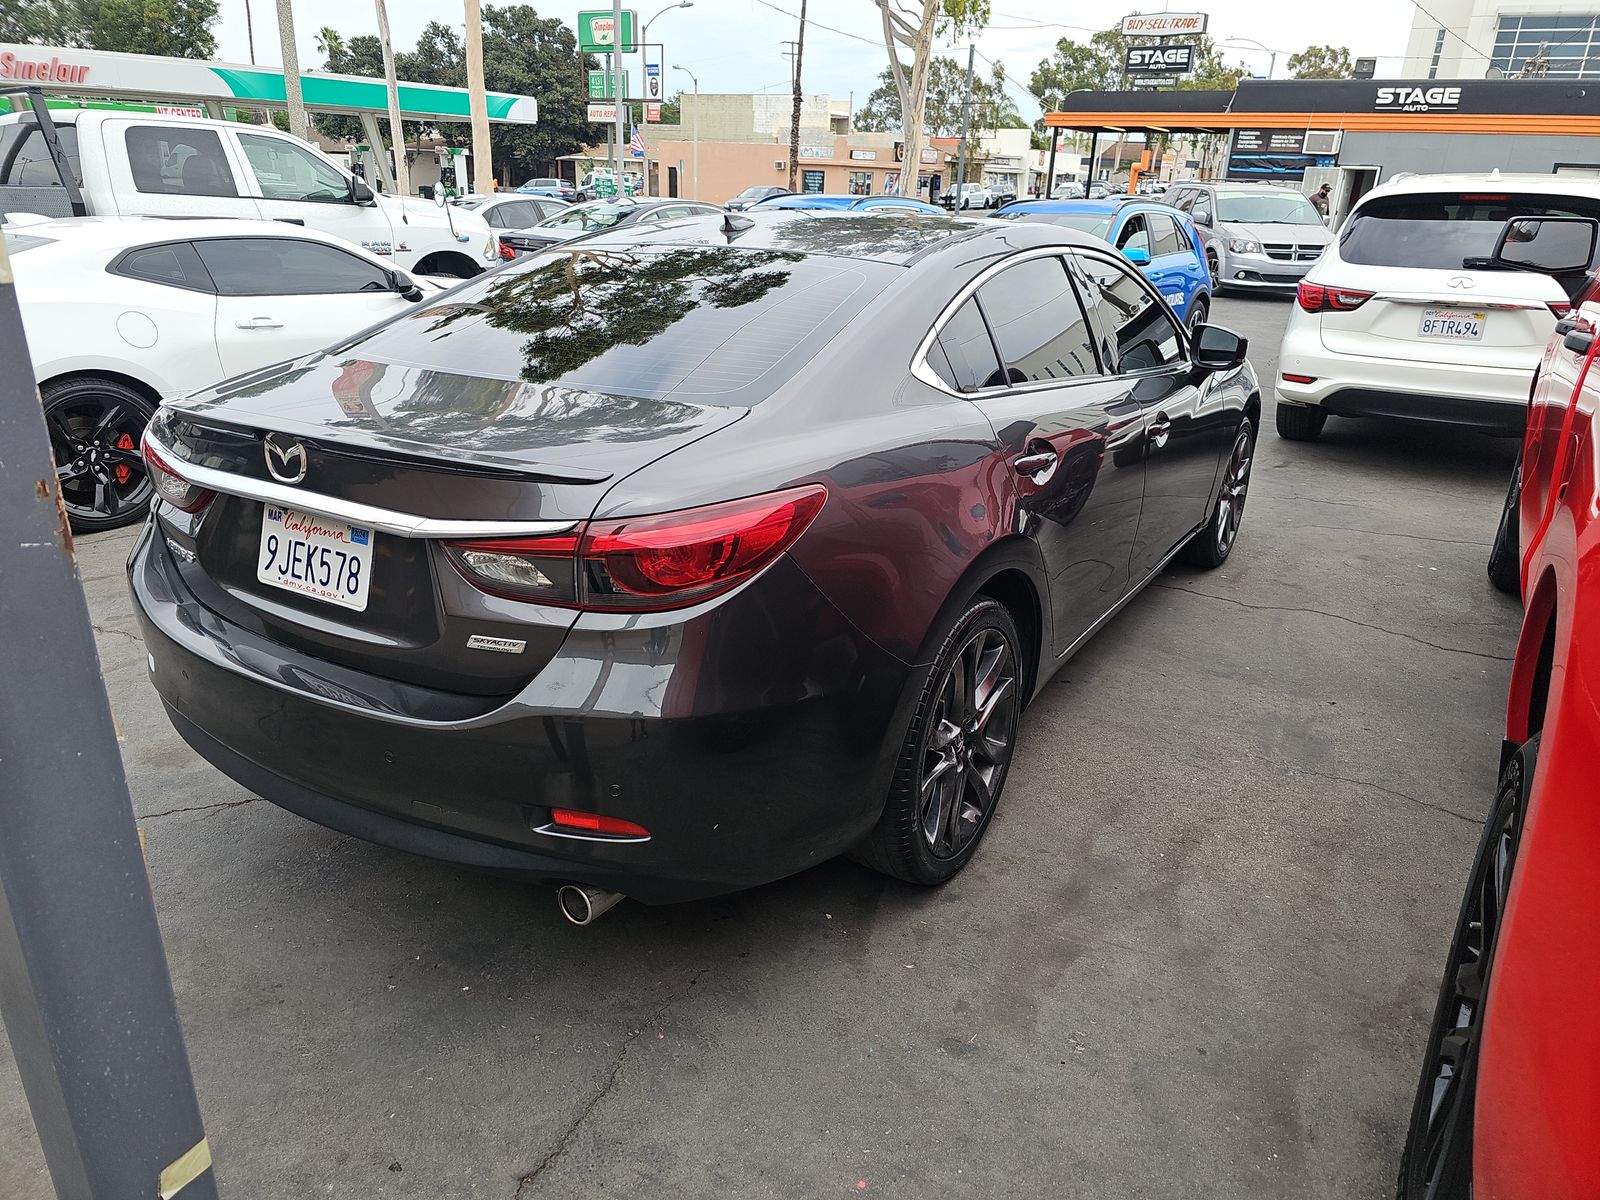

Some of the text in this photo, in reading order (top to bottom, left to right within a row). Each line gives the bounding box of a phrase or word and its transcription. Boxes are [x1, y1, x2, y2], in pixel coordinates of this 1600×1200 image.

[1128, 49, 1189, 64] STAGE
[0, 52, 90, 83] Sinclair
[1375, 87, 1462, 104] STAGE
[590, 110, 603, 118] AUTO
[1402, 104, 1429, 112] AUTO
[1434, 309, 1474, 320] California
[1423, 319, 1478, 337] 8FTR494
[267, 508, 282, 523] MAR
[284, 511, 351, 544] California
[264, 534, 361, 595] 9JEK578
[282, 578, 339, 599] dmv.ca.gov
[472, 637, 520, 648] SKYACTIV
